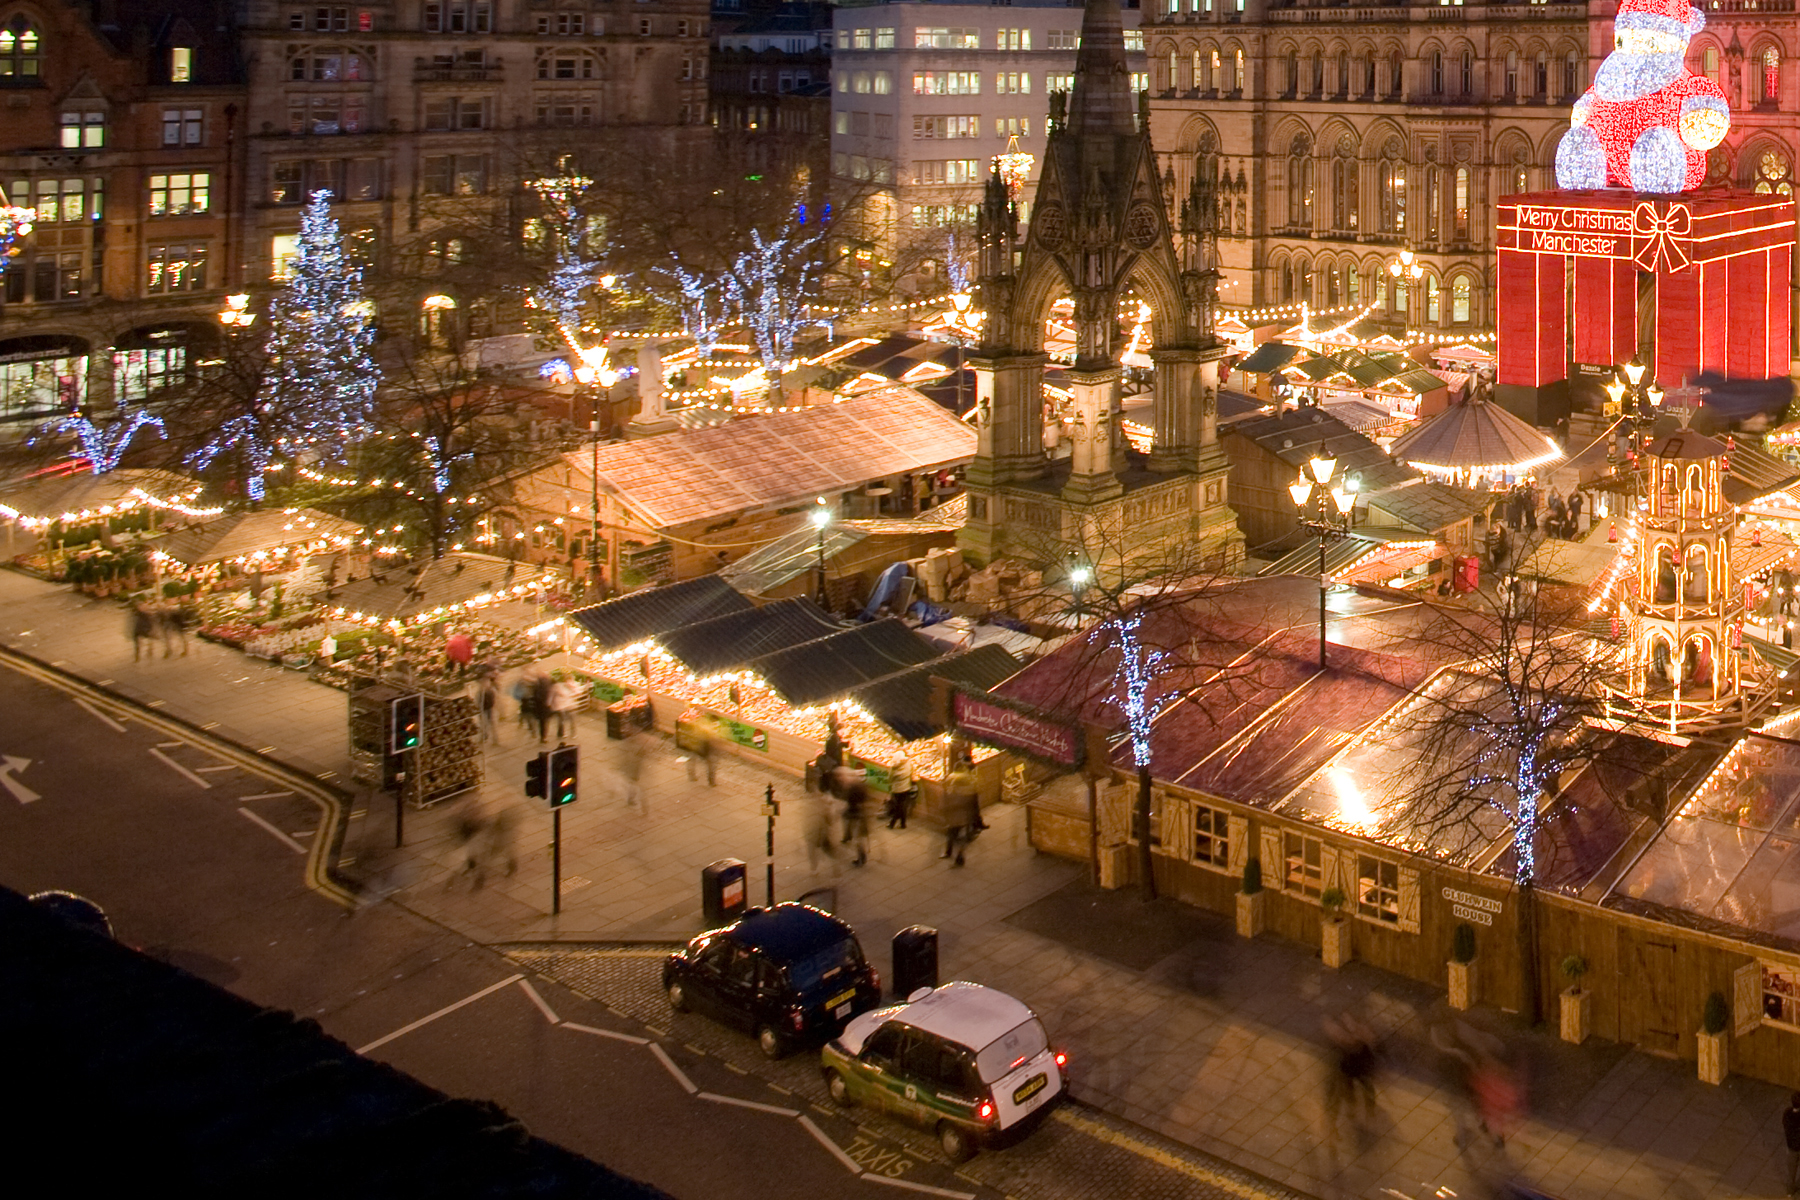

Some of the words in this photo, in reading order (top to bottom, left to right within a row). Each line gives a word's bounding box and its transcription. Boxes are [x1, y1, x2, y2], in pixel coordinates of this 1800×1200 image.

[1519, 207, 1559, 231] Merry
[1562, 208, 1632, 231] Christmas
[1532, 230, 1617, 254] Manchester
[1453, 904, 1493, 926] HOUSE
[843, 1135, 914, 1178] TAXIS
